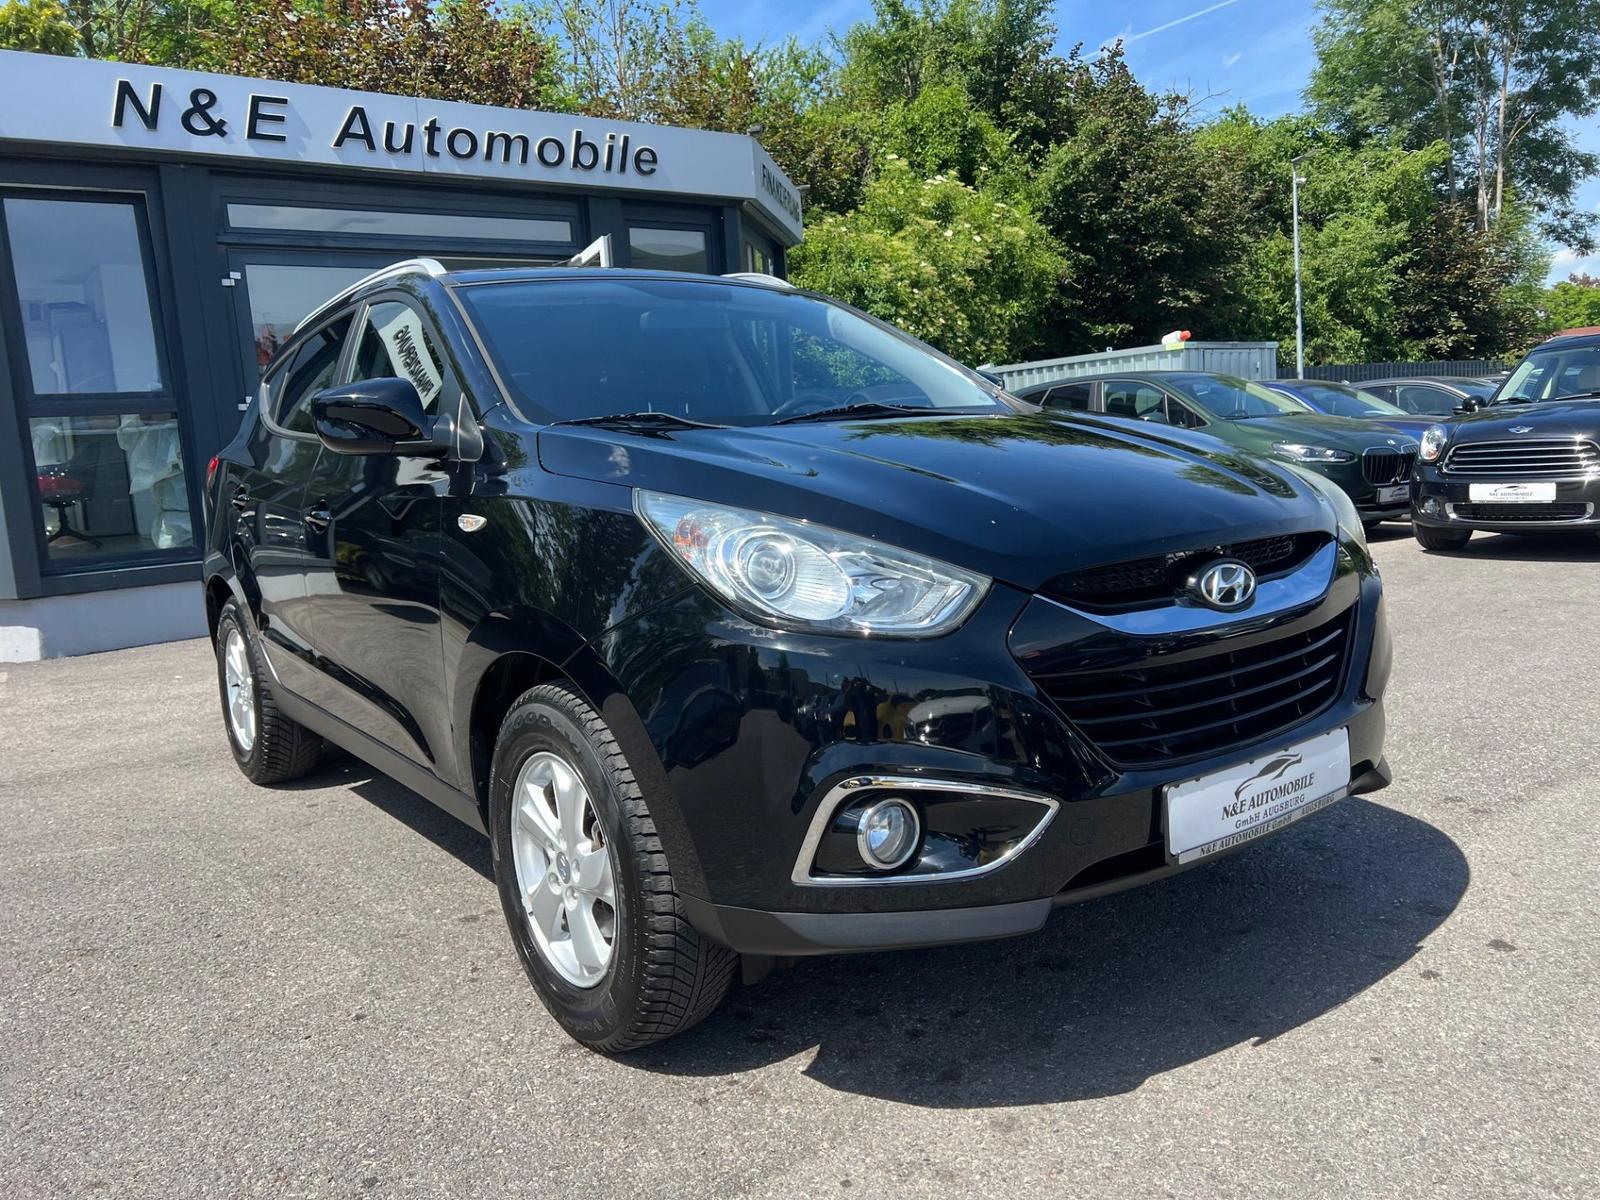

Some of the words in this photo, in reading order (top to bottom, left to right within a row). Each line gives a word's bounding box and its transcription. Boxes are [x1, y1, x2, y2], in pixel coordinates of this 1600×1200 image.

[330, 105, 658, 176] Automobile
[1221, 799, 1247, 820] N&E
[1247, 772, 1315, 811] AUTOMOBILE
[1235, 813, 1260, 829] GmbH
[1262, 794, 1305, 819] AUGSBURG
[1199, 842, 1218, 856] N&E
[1218, 823, 1272, 851] AUTOMOBILE
